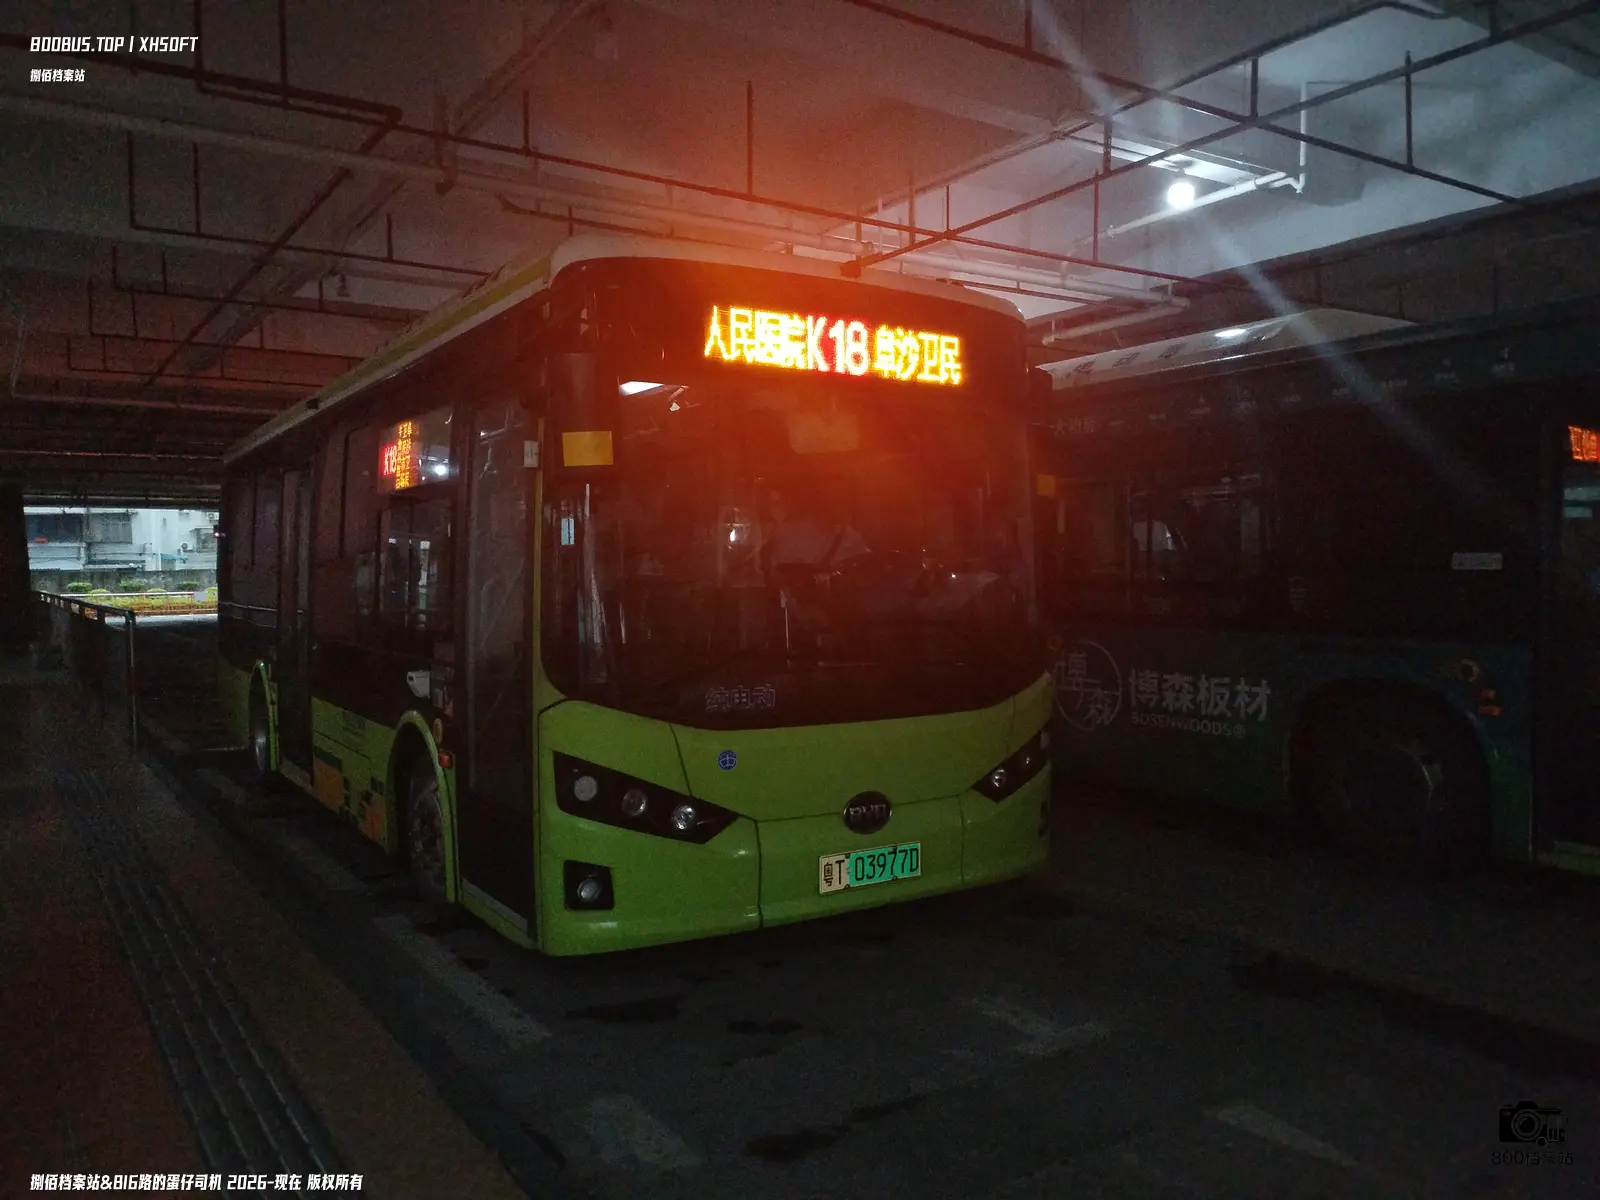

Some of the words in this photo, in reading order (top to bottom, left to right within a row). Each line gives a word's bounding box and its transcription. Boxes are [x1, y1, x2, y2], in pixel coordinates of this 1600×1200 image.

[704, 304, 806, 369] 人民医院
[806, 314, 869, 376] K18
[1129, 668, 1271, 722] 博森板材
[823, 860, 846, 887] 粤T
[855, 847, 919, 882] 03977D
